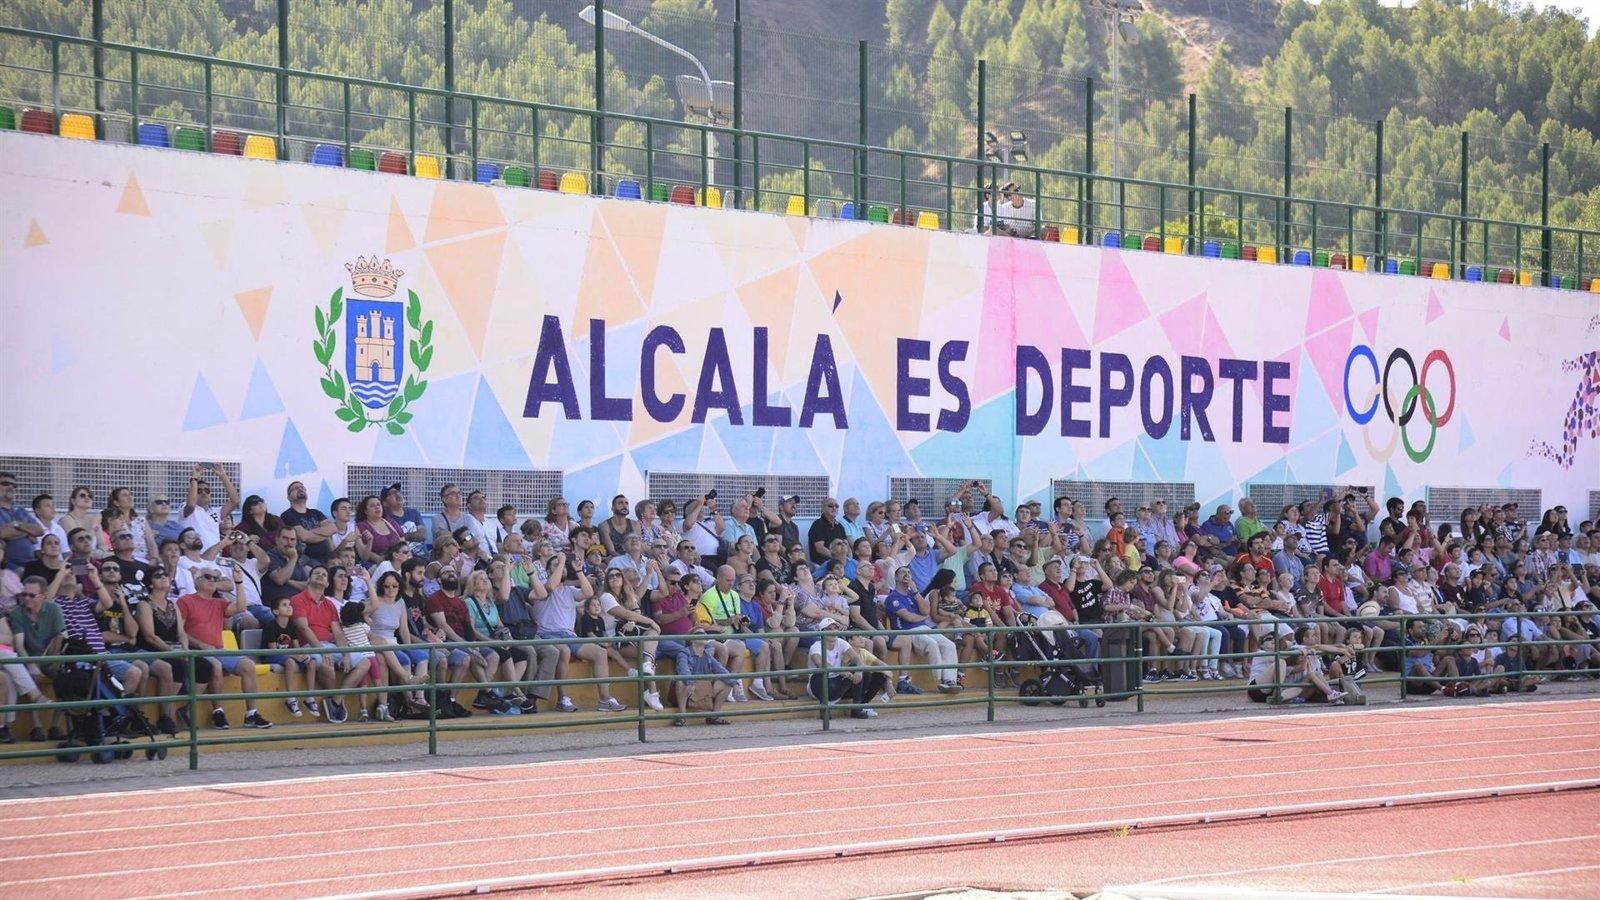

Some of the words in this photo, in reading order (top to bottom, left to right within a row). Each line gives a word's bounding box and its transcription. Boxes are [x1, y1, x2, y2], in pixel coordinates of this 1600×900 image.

[523, 291, 849, 430] ALCALÁ
[896, 337, 971, 433] ES
[1015, 345, 1291, 444] DEPORTE
